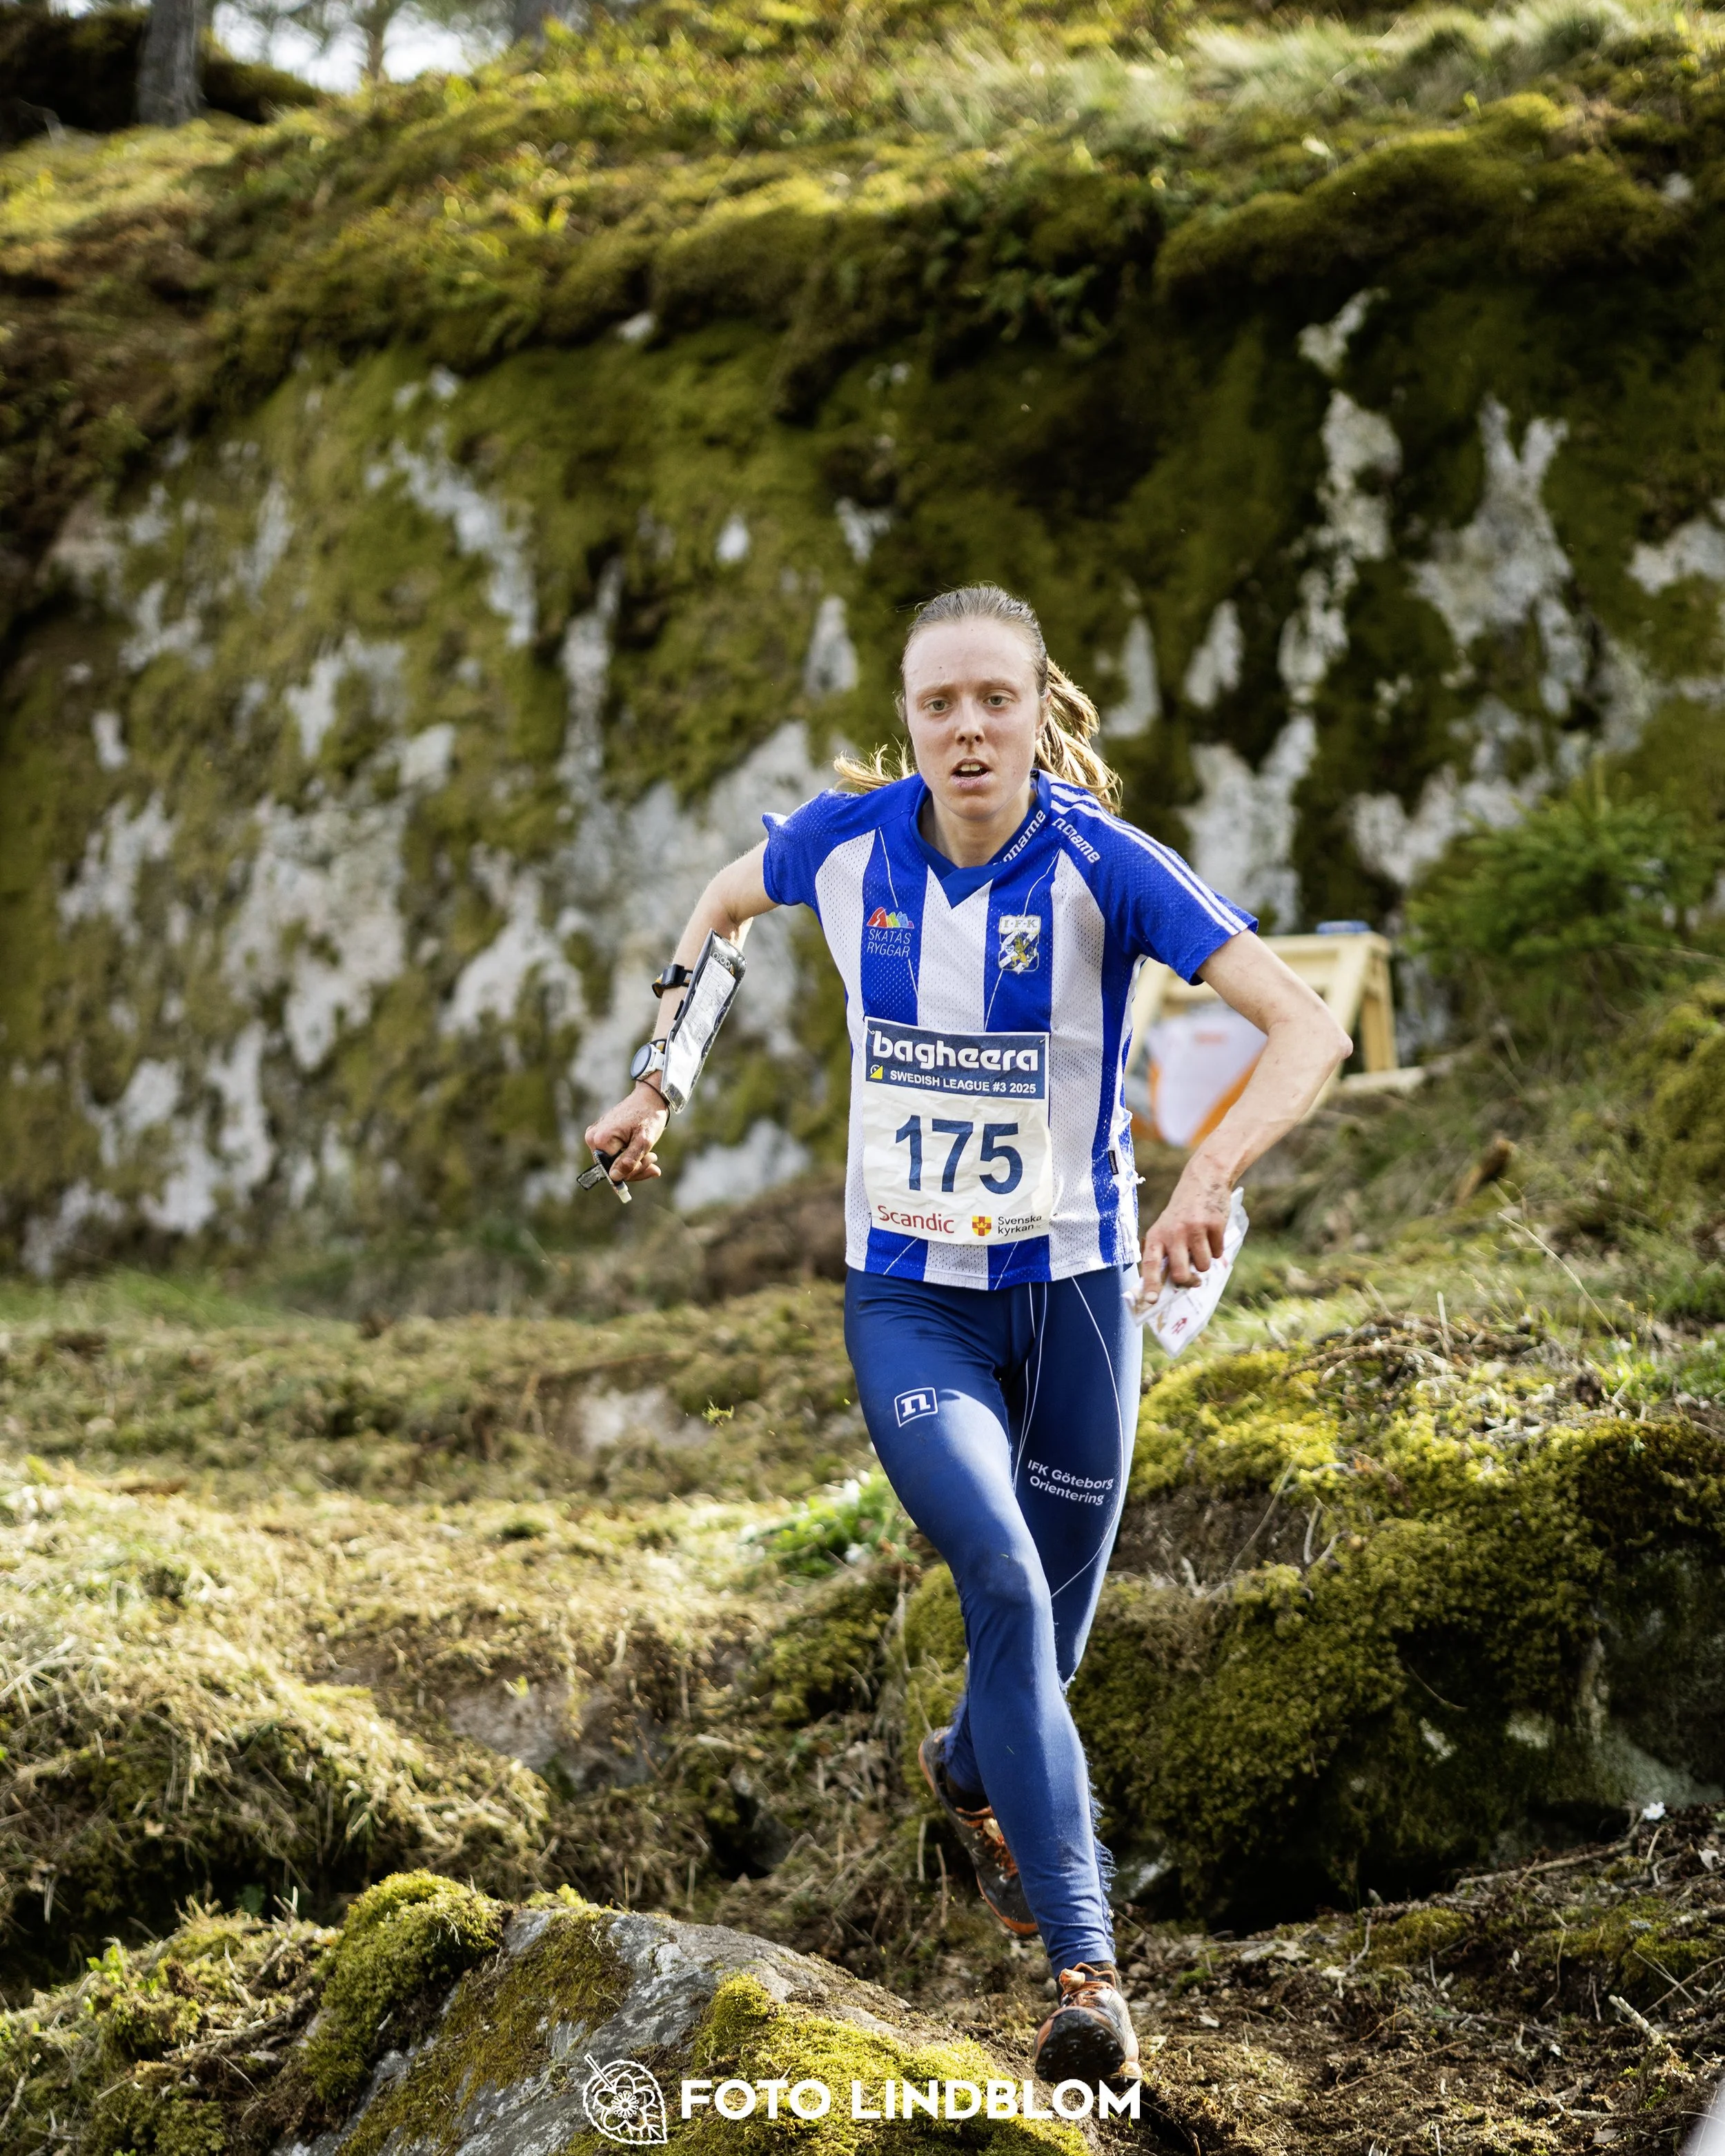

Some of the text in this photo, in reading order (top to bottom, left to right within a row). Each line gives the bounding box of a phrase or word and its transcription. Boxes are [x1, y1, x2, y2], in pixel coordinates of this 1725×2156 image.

[993, 809, 1046, 865] oname
[1052, 818, 1101, 863] noname
[867, 942, 910, 958] RYGGAR
[868, 929, 911, 944] SKATÅS
[873, 1030, 1038, 1071] bagheera
[890, 1070, 1036, 1094] SWEDISH LEAGUE #3 2025
[895, 1114, 1023, 1195] 175
[877, 1205, 955, 1234] Scandic
[998, 1214, 1043, 1226] Svenska
[998, 1224, 1034, 1236] kyrkan
[1027, 1459, 1114, 1490] IFK Göteborg
[1029, 1476, 1105, 1505] Orientering
